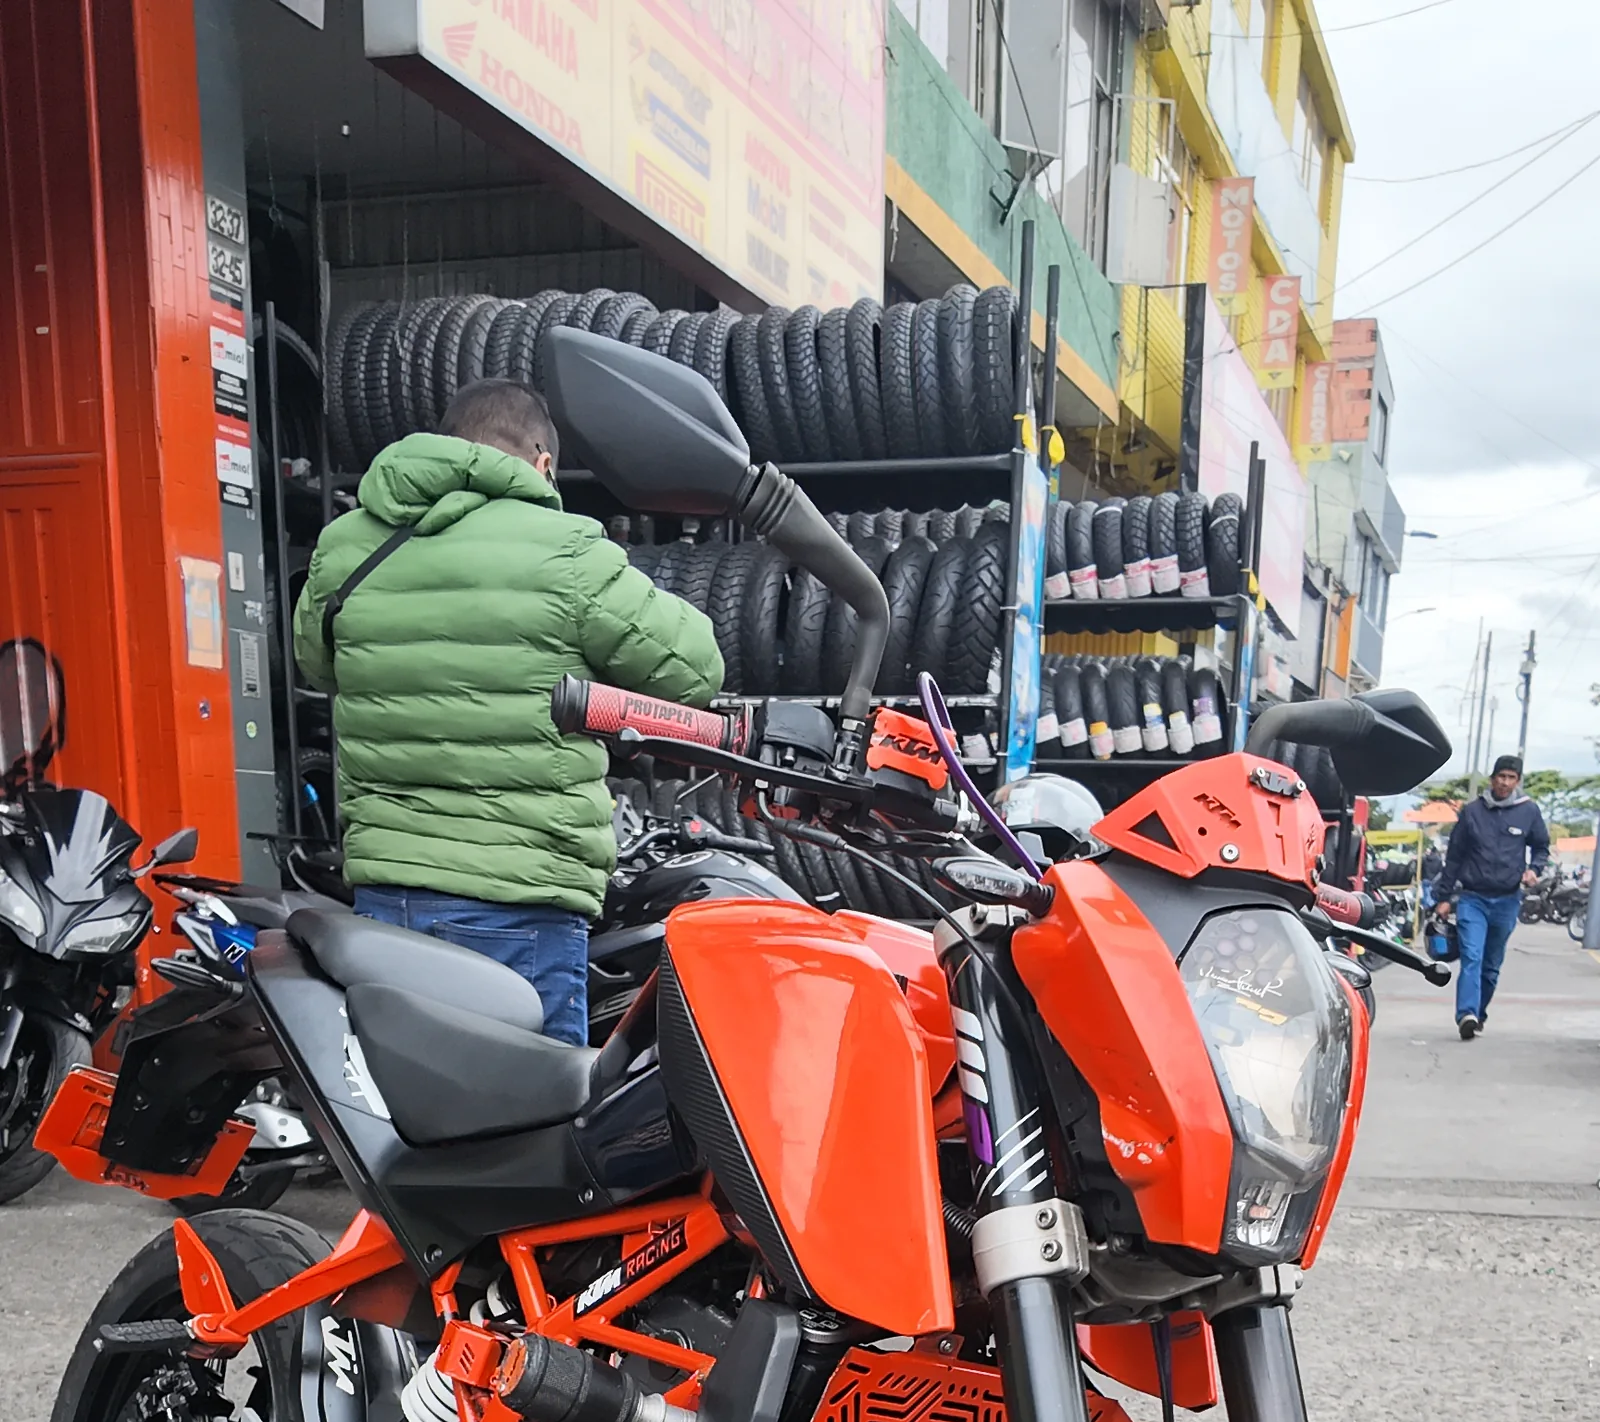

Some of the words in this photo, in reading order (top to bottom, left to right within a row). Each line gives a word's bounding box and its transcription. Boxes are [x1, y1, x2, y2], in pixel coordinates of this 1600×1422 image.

[493, 0, 579, 81] AMAHA
[479, 48, 587, 160] HONDA
[635, 150, 706, 246] PIRELLI
[1217, 186, 1249, 292] MOTOS
[1266, 280, 1293, 364] CDA
[621, 696, 693, 727] PROTAPER
[880, 733, 942, 766] KTM
[1193, 793, 1242, 828] KTM
[577, 1267, 622, 1314] KTM
[625, 1228, 681, 1279] RACING
